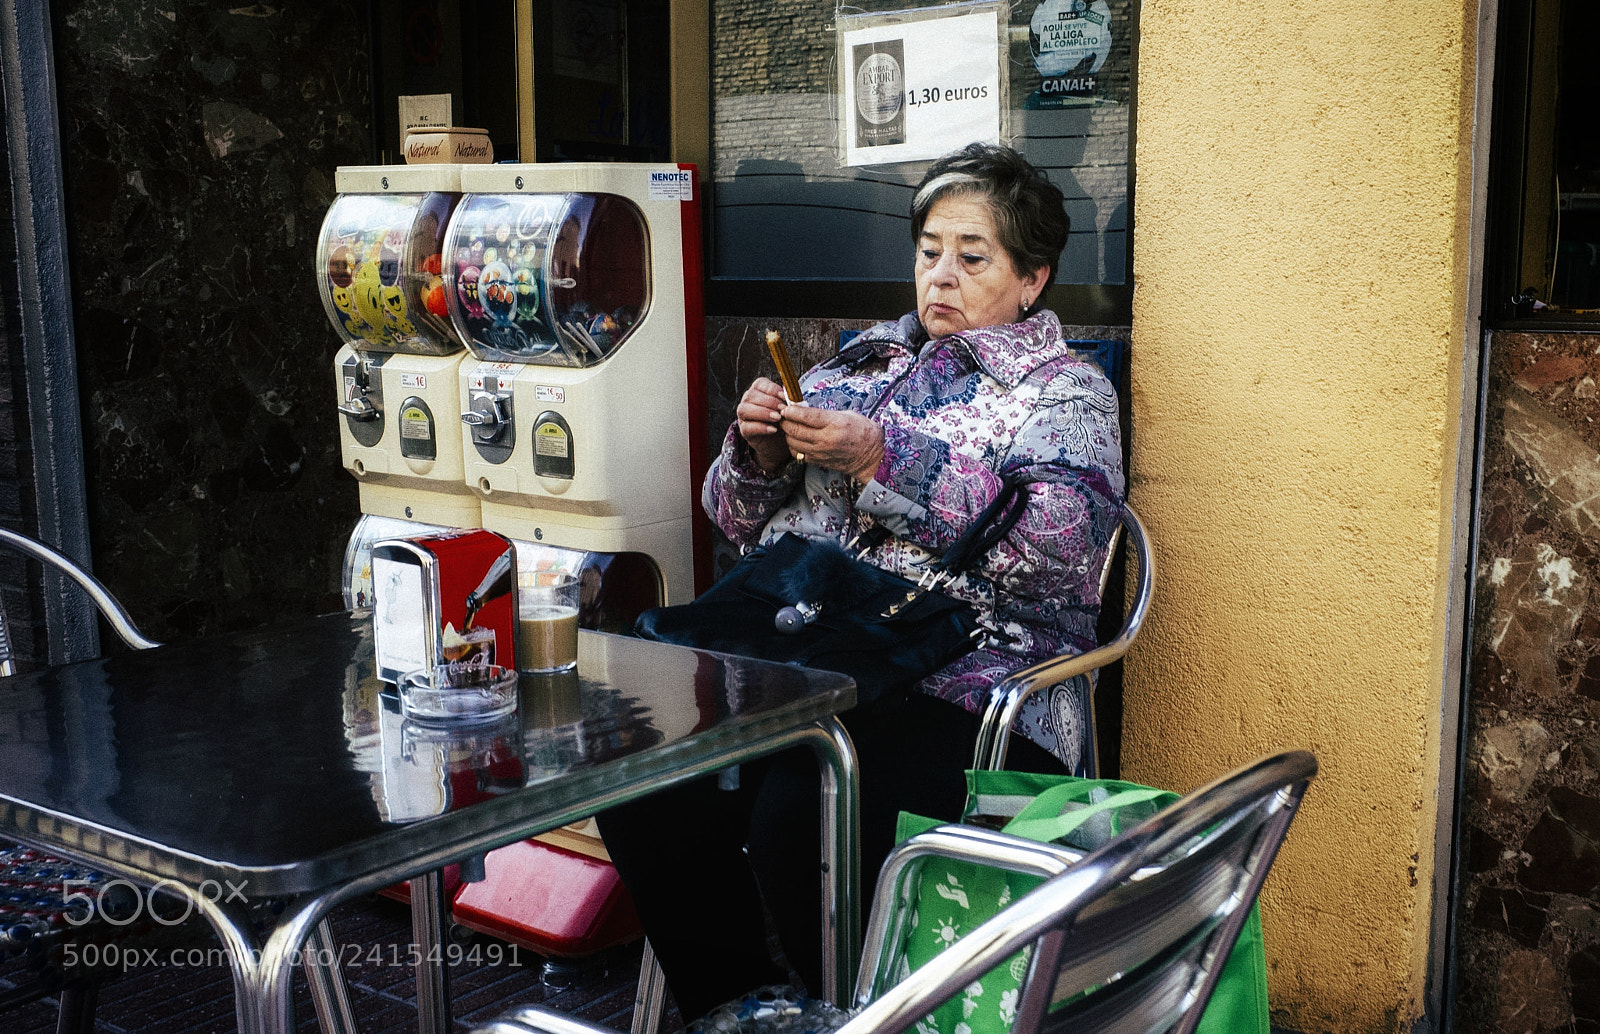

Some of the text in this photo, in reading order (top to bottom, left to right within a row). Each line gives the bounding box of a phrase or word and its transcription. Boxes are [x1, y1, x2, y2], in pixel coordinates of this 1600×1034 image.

[1043, 22, 1063, 32] AQUÍ
[1050, 30, 1083, 40] LA LIGA
[1042, 37, 1098, 49] AL COMPLETO
[869, 65, 890, 74] AMBAR
[862, 69, 896, 86] EXPORT
[1042, 78, 1095, 92] CANAL+
[908, 87, 940, 107] 1,30
[944, 85, 988, 102] euros
[407, 139, 444, 159] Natural
[454, 141, 490, 158] Natural
[651, 173, 689, 181] NENOTEC
